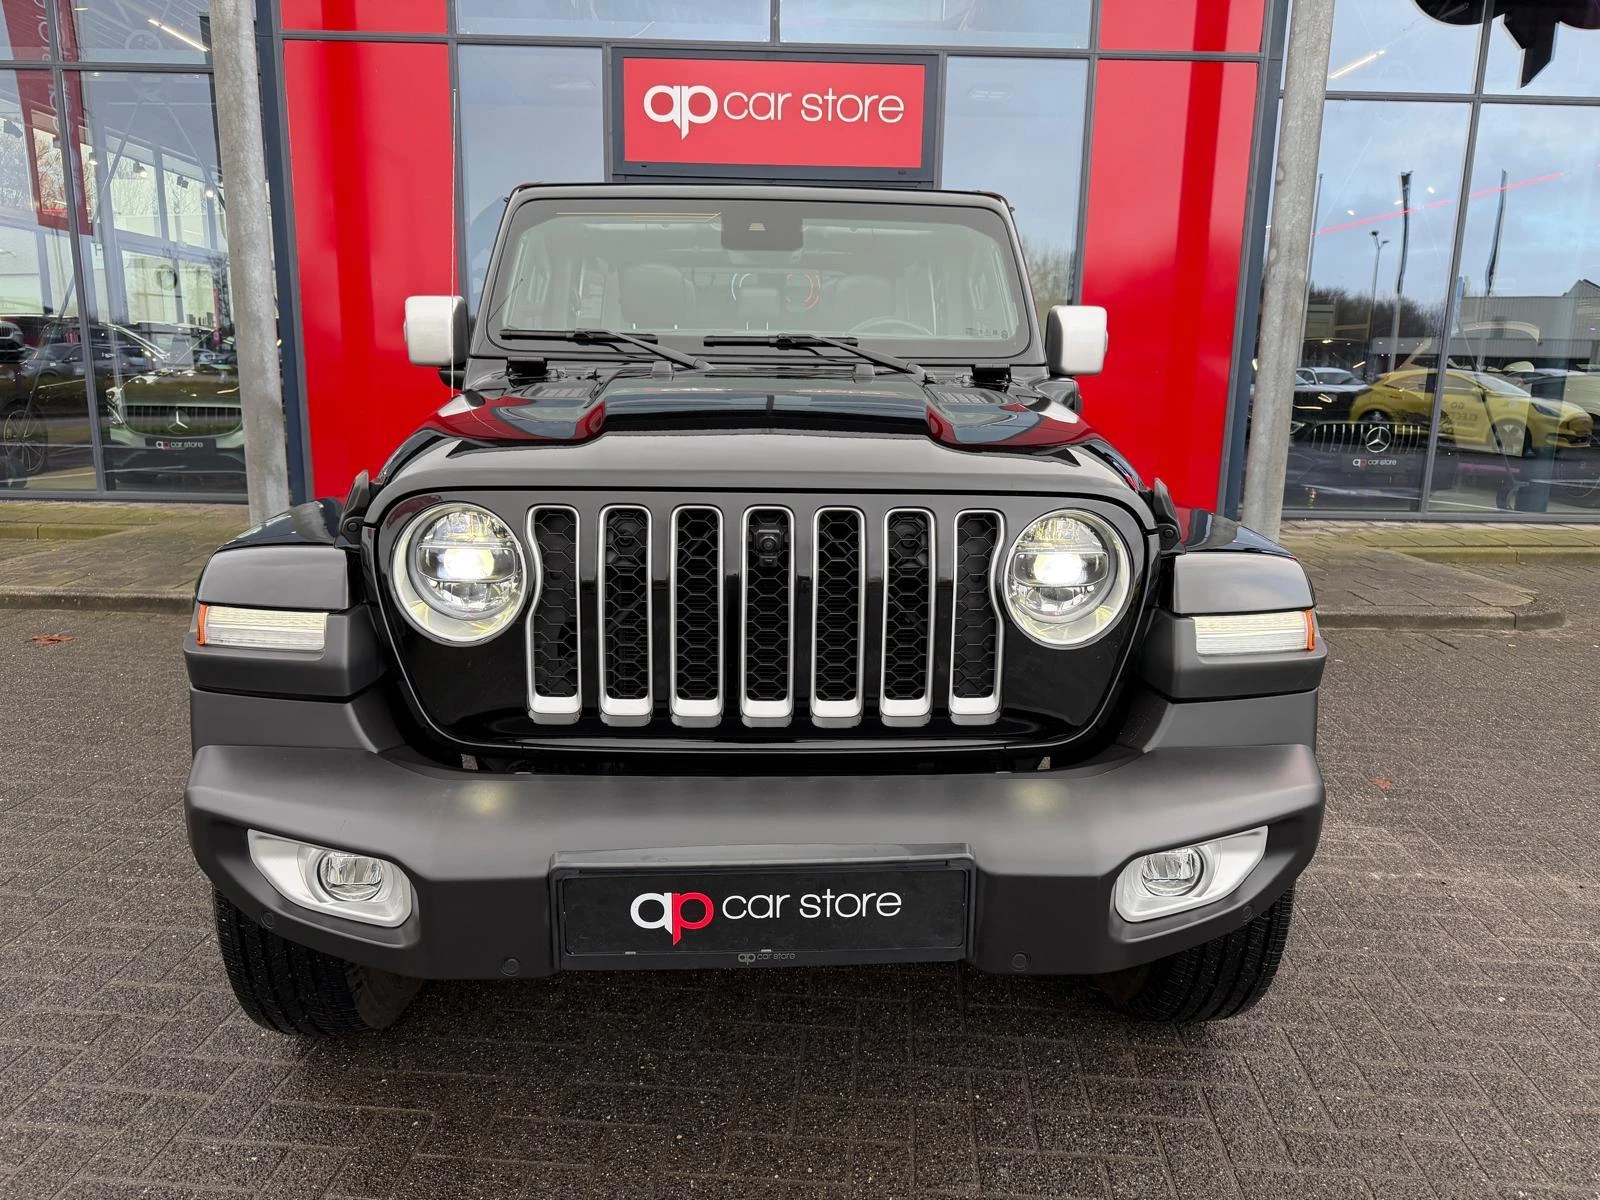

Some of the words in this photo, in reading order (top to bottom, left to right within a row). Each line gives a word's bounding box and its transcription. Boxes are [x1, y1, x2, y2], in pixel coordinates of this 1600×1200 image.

[643, 84, 719, 141] ap
[723, 91, 793, 121] car
[800, 87, 905, 124] store
[170, 440, 183, 448] car
[183, 440, 204, 449] store
[1379, 458, 1397, 466] store
[630, 892, 715, 947] ap
[722, 894, 791, 920] car
[799, 888, 902, 918] store
[737, 953, 756, 966] ap
[773, 952, 796, 960] store
